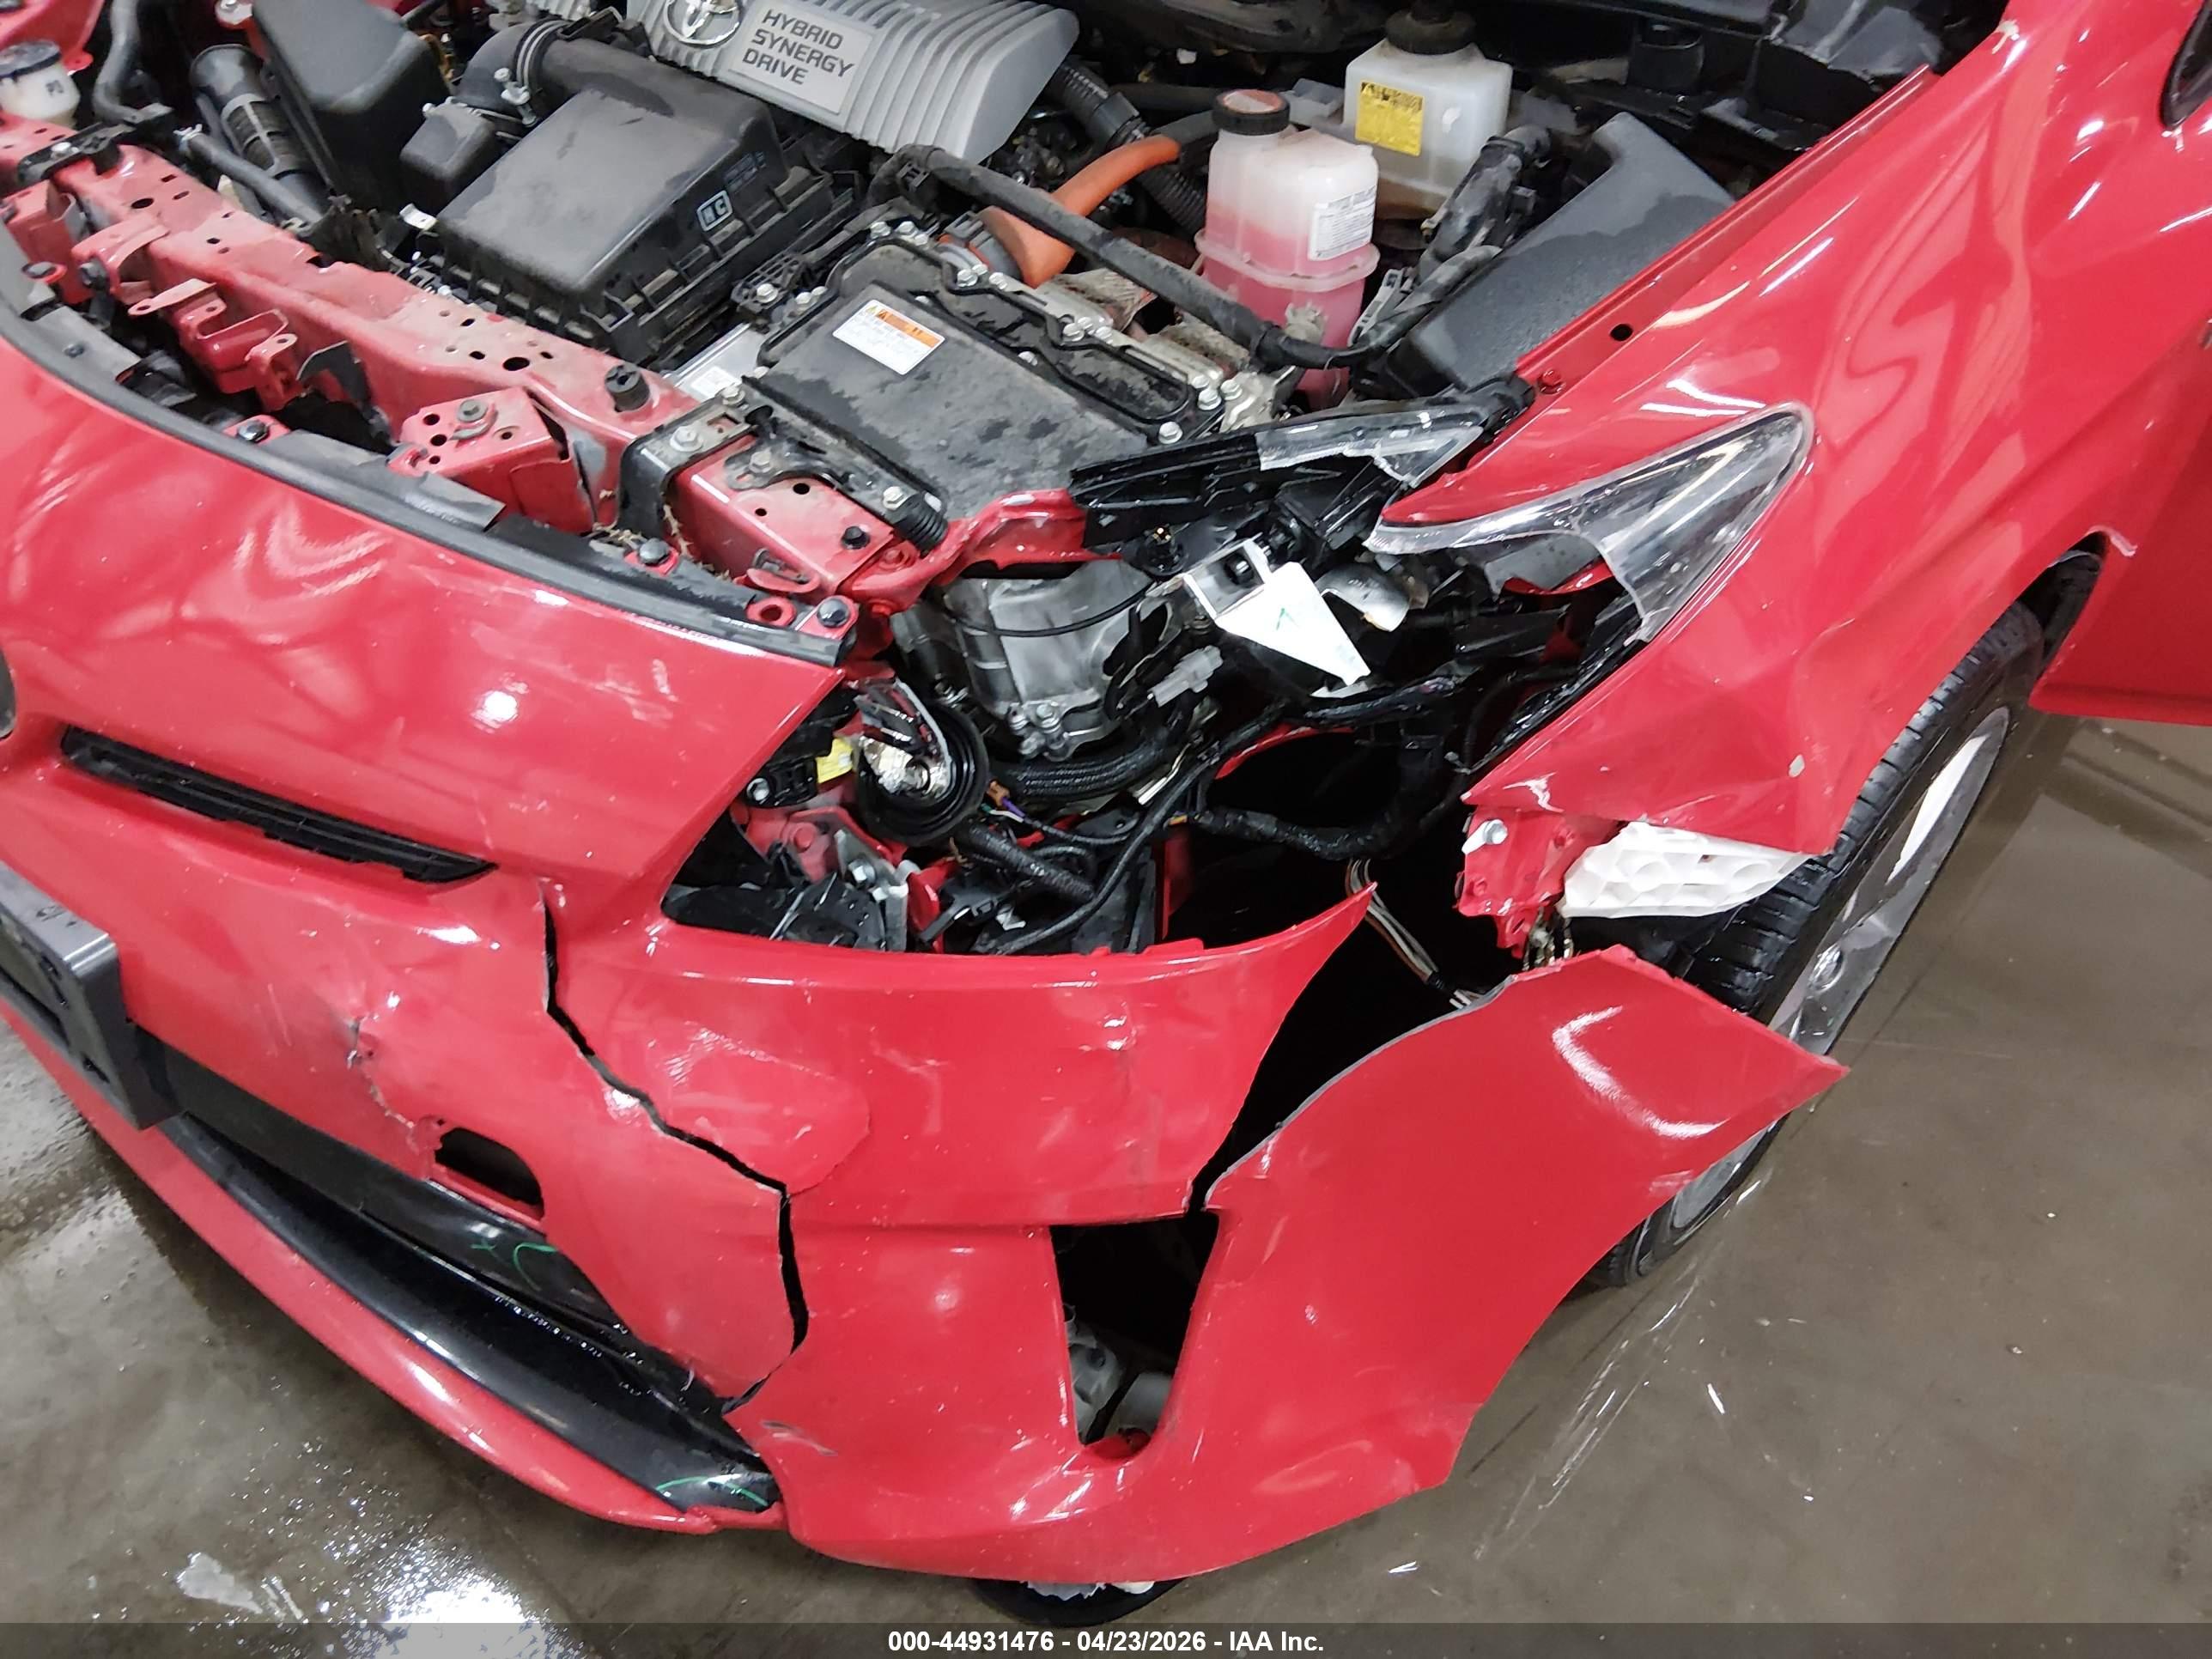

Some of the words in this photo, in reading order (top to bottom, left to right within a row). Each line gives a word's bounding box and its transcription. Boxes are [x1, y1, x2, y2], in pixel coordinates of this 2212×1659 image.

[762, 9, 843, 50] HYBRID
[743, 48, 808, 85] DRIVE
[751, 28, 854, 76] SYNERGY
